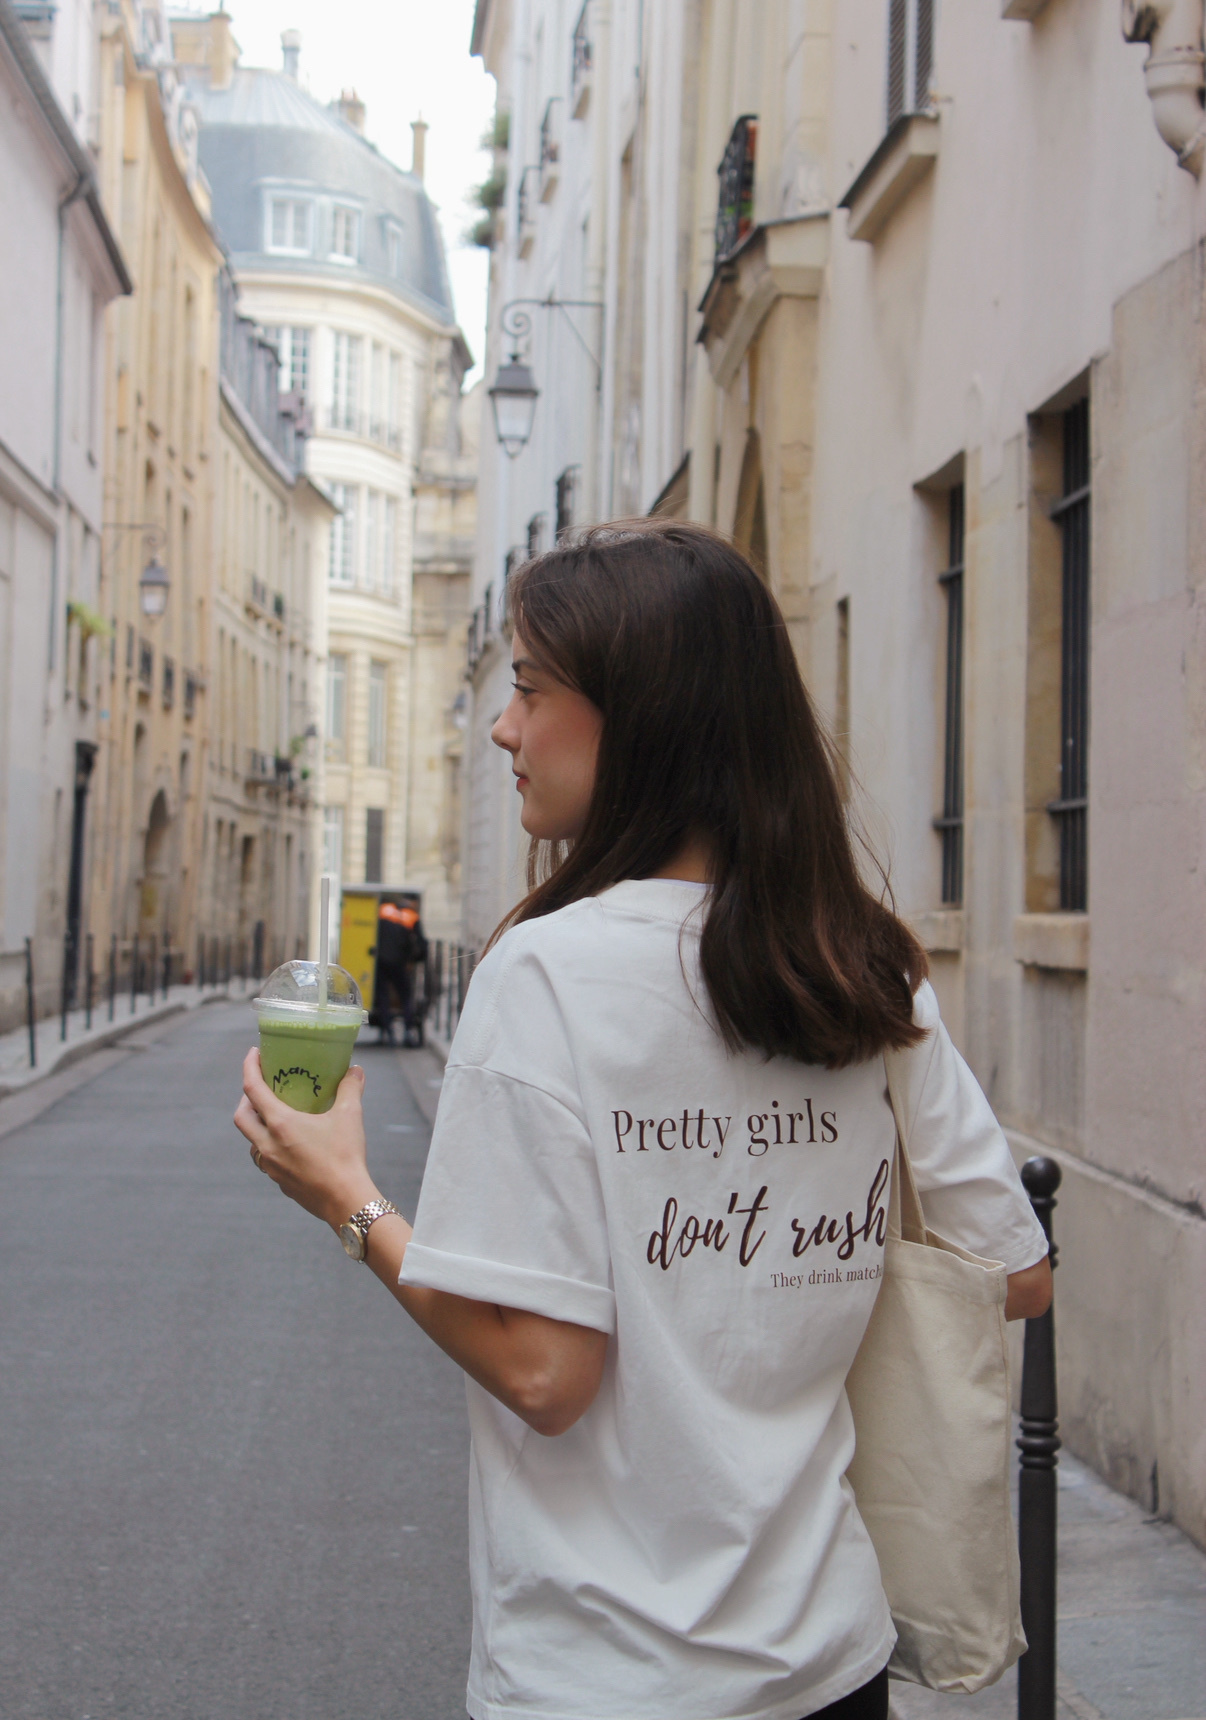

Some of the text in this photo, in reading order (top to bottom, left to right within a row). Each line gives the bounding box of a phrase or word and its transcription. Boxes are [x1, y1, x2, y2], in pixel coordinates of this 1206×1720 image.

[611, 1098, 839, 1159] Pretty girls
[646, 1158, 890, 1271] don't rush
[770, 1264, 884, 1289] They drink match
